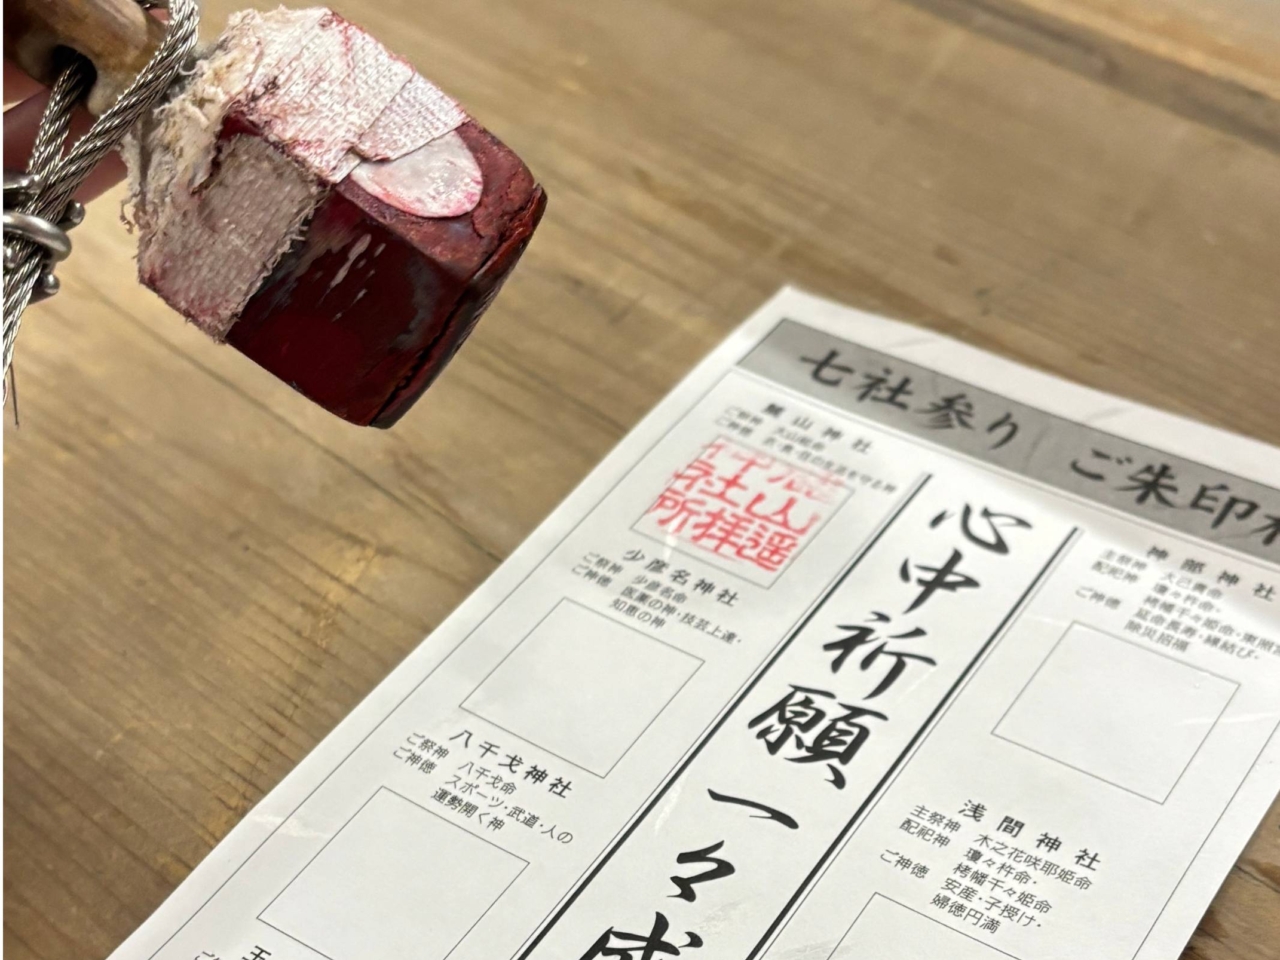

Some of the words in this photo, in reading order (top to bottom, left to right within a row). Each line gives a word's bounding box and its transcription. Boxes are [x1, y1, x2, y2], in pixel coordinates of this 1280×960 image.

[800, 349, 1019, 451] 七社参り
[622, 549, 739, 607] 少彦名神社
[610, 598, 667, 630] 知恵の神
[393, 746, 438, 775] ご神徳
[406, 732, 450, 761] ご祭神
[458, 761, 518, 796] 八千戈命
[448, 729, 573, 799] 八千戈神社
[430, 787, 506, 832] 運勢開く神
[898, 817, 952, 849] 配祀神
[910, 804, 962, 834] 主祭神
[973, 833, 1093, 891] 木之花咲耶姫命
[958, 799, 1101, 872] 浅間神社
[880, 848, 930, 880] ご神徳
[929, 892, 1001, 934] 婦徳円満
